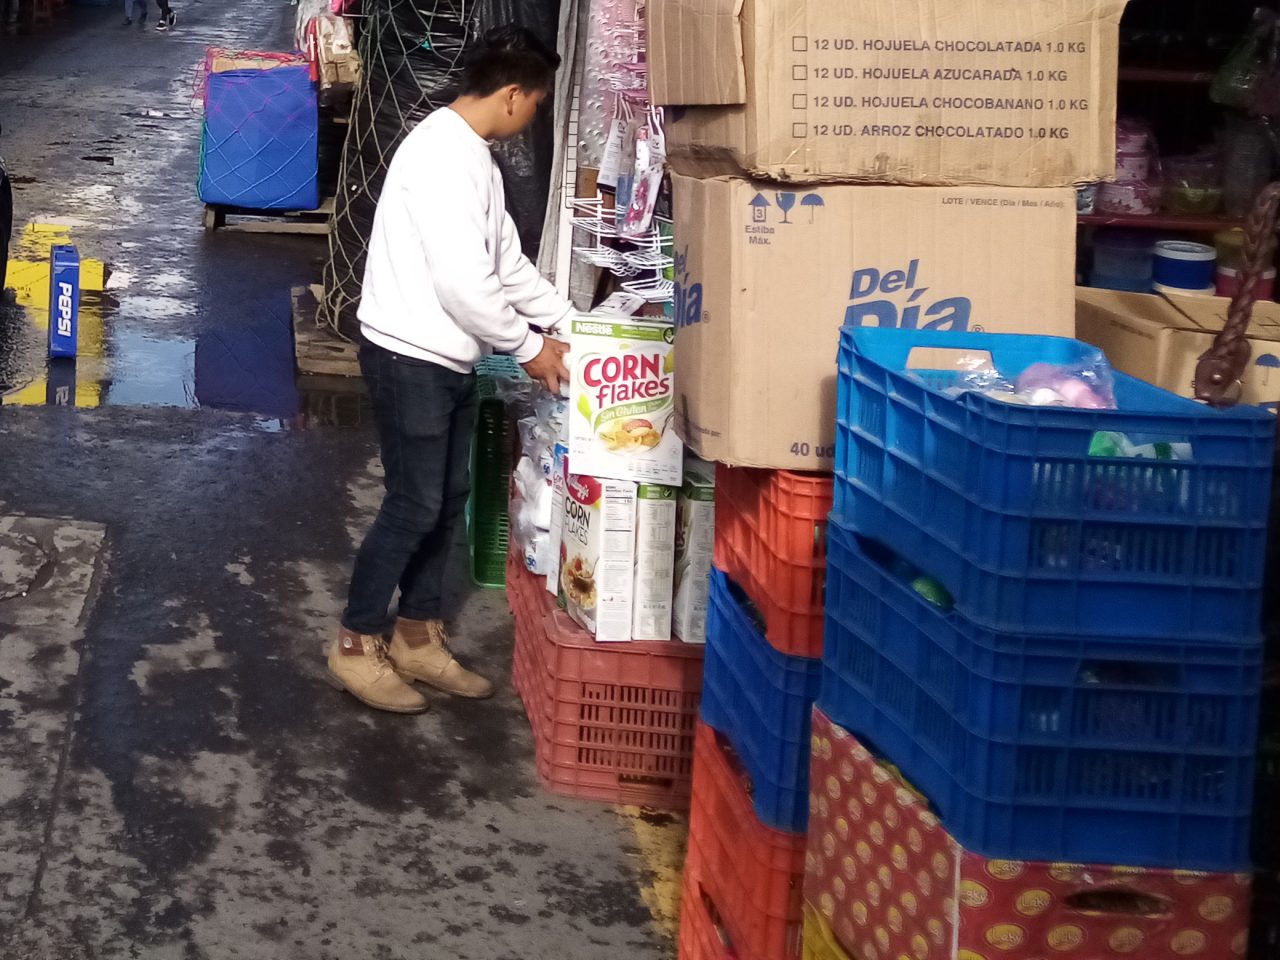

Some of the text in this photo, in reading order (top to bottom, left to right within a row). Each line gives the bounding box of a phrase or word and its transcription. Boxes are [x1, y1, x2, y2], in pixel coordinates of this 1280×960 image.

[815, 39, 1086, 53] 12 UD. HOJUELA CHOCOLATADA 1.0 KG
[814, 68, 1067, 82] 12 UD. HOJUELA AZUCARADA 1.0 KG
[814, 97, 1088, 110] 12 UD. HOJUELA CHOCOBANANO 1.0 KG
[813, 125, 1069, 139] 12 UD. ARROZ CHOCOLATADO 1.0 KG
[745, 225, 775, 235] Estiba
[849, 259, 919, 300] Del
[57, 281, 73, 337] PEPSI
[583, 354, 660, 388] CORN
[596, 377, 669, 409] flakes
[601, 411, 614, 423] Sin
[616, 404, 647, 418] Gluten
[790, 442, 809, 456] 40
[565, 496, 591, 529] CORN
